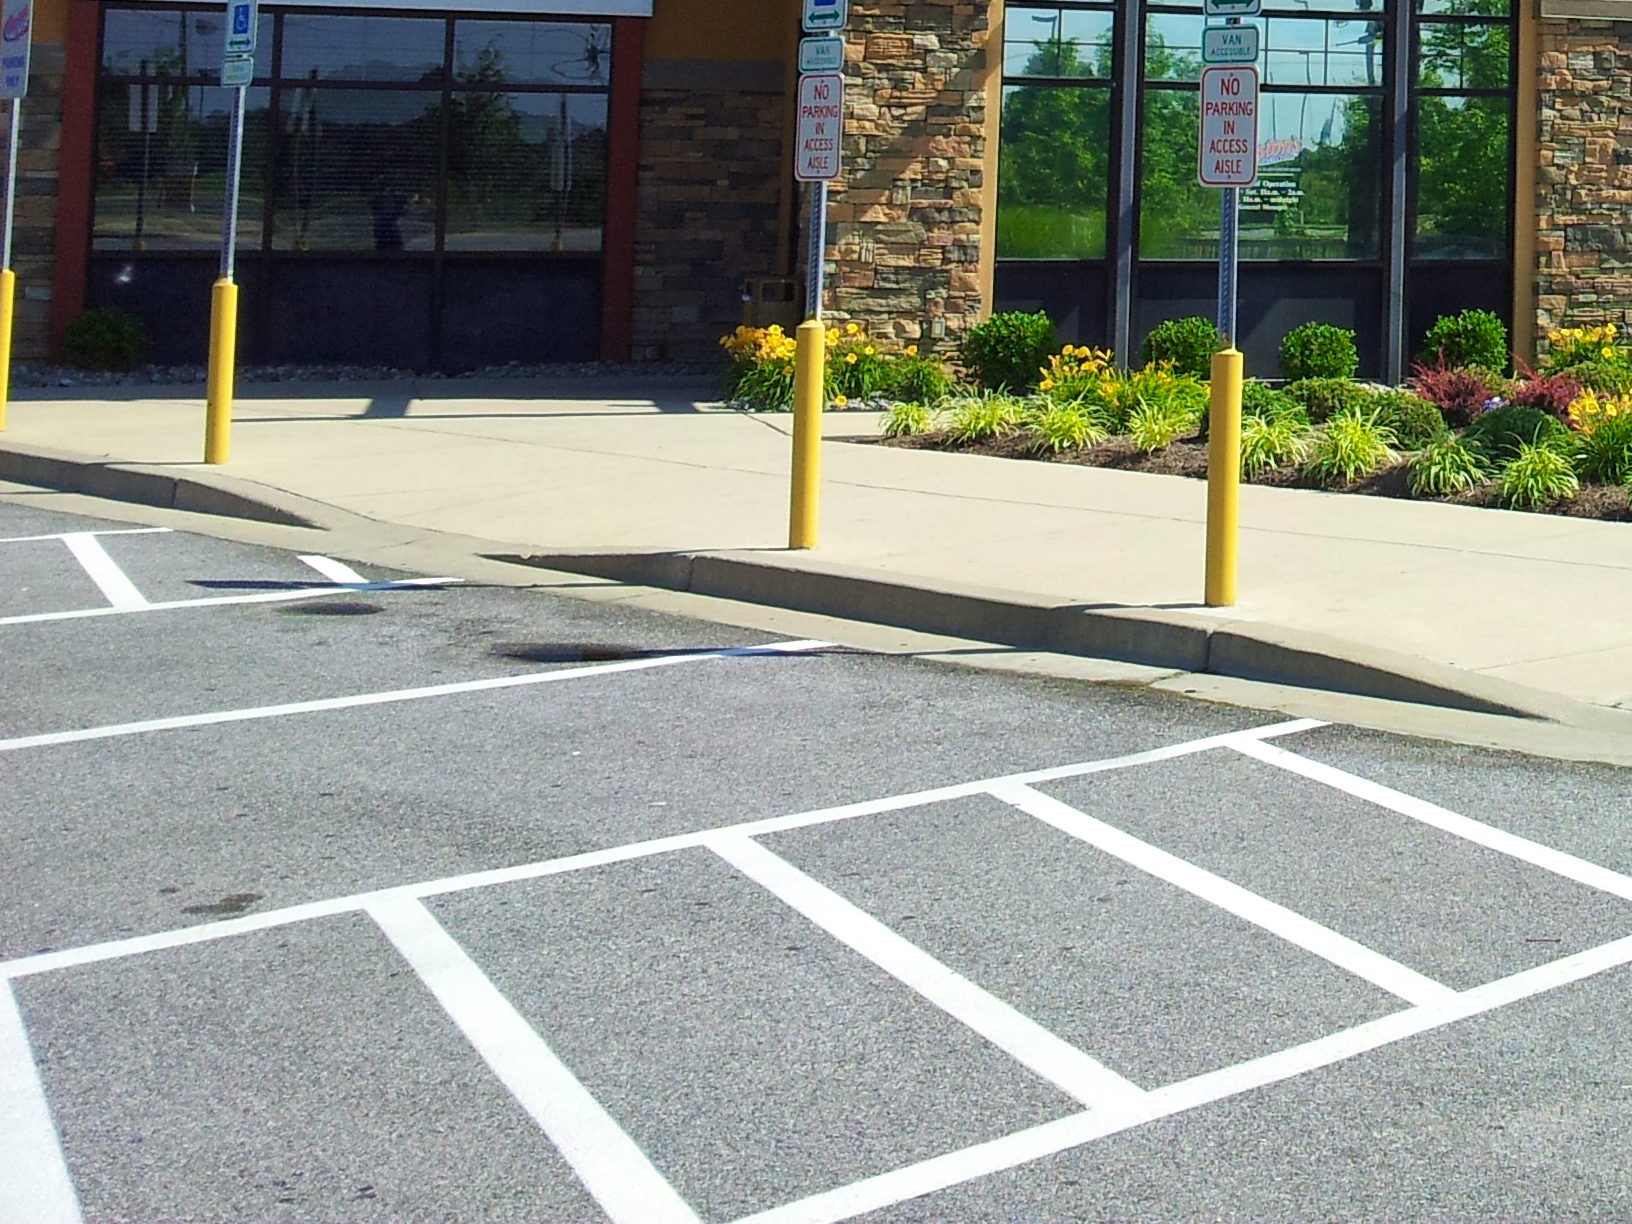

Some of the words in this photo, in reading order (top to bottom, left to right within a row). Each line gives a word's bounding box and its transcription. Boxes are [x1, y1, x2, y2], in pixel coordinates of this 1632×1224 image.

[1222, 34, 1242, 45] VAN
[814, 84, 830, 100] NO
[1220, 78, 1241, 95] NO
[802, 104, 838, 118] PARKING
[1206, 101, 1253, 116] PARKING
[815, 122, 825, 135] IN
[1223, 119, 1236, 135] IN
[804, 137, 833, 151] ACCESS
[1209, 138, 1248, 153] ACCESS
[807, 156, 829, 170] AISLE
[1214, 159, 1242, 174] AISLE
